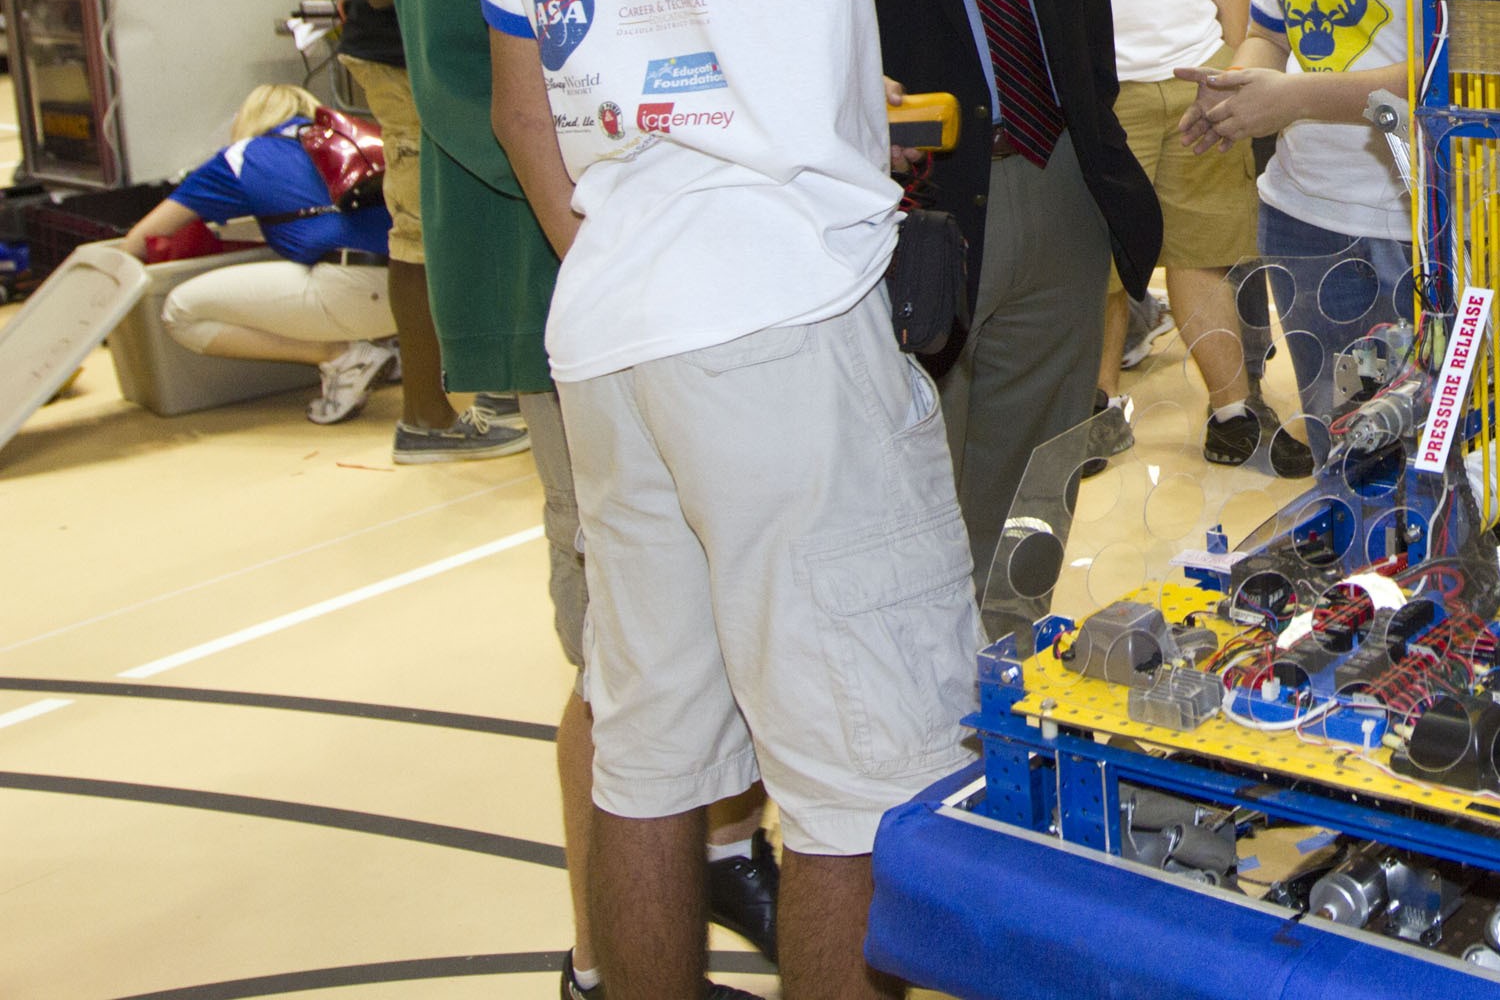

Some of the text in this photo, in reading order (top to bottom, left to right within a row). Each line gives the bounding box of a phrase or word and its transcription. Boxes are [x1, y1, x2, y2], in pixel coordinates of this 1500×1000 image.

[536, 0, 587, 25] ASA
[656, 2, 664, 13] &
[565, 73, 601, 88] World
[638, 109, 735, 132] jcpenney
[1424, 295, 1485, 463] PRESSURE RELEASE
